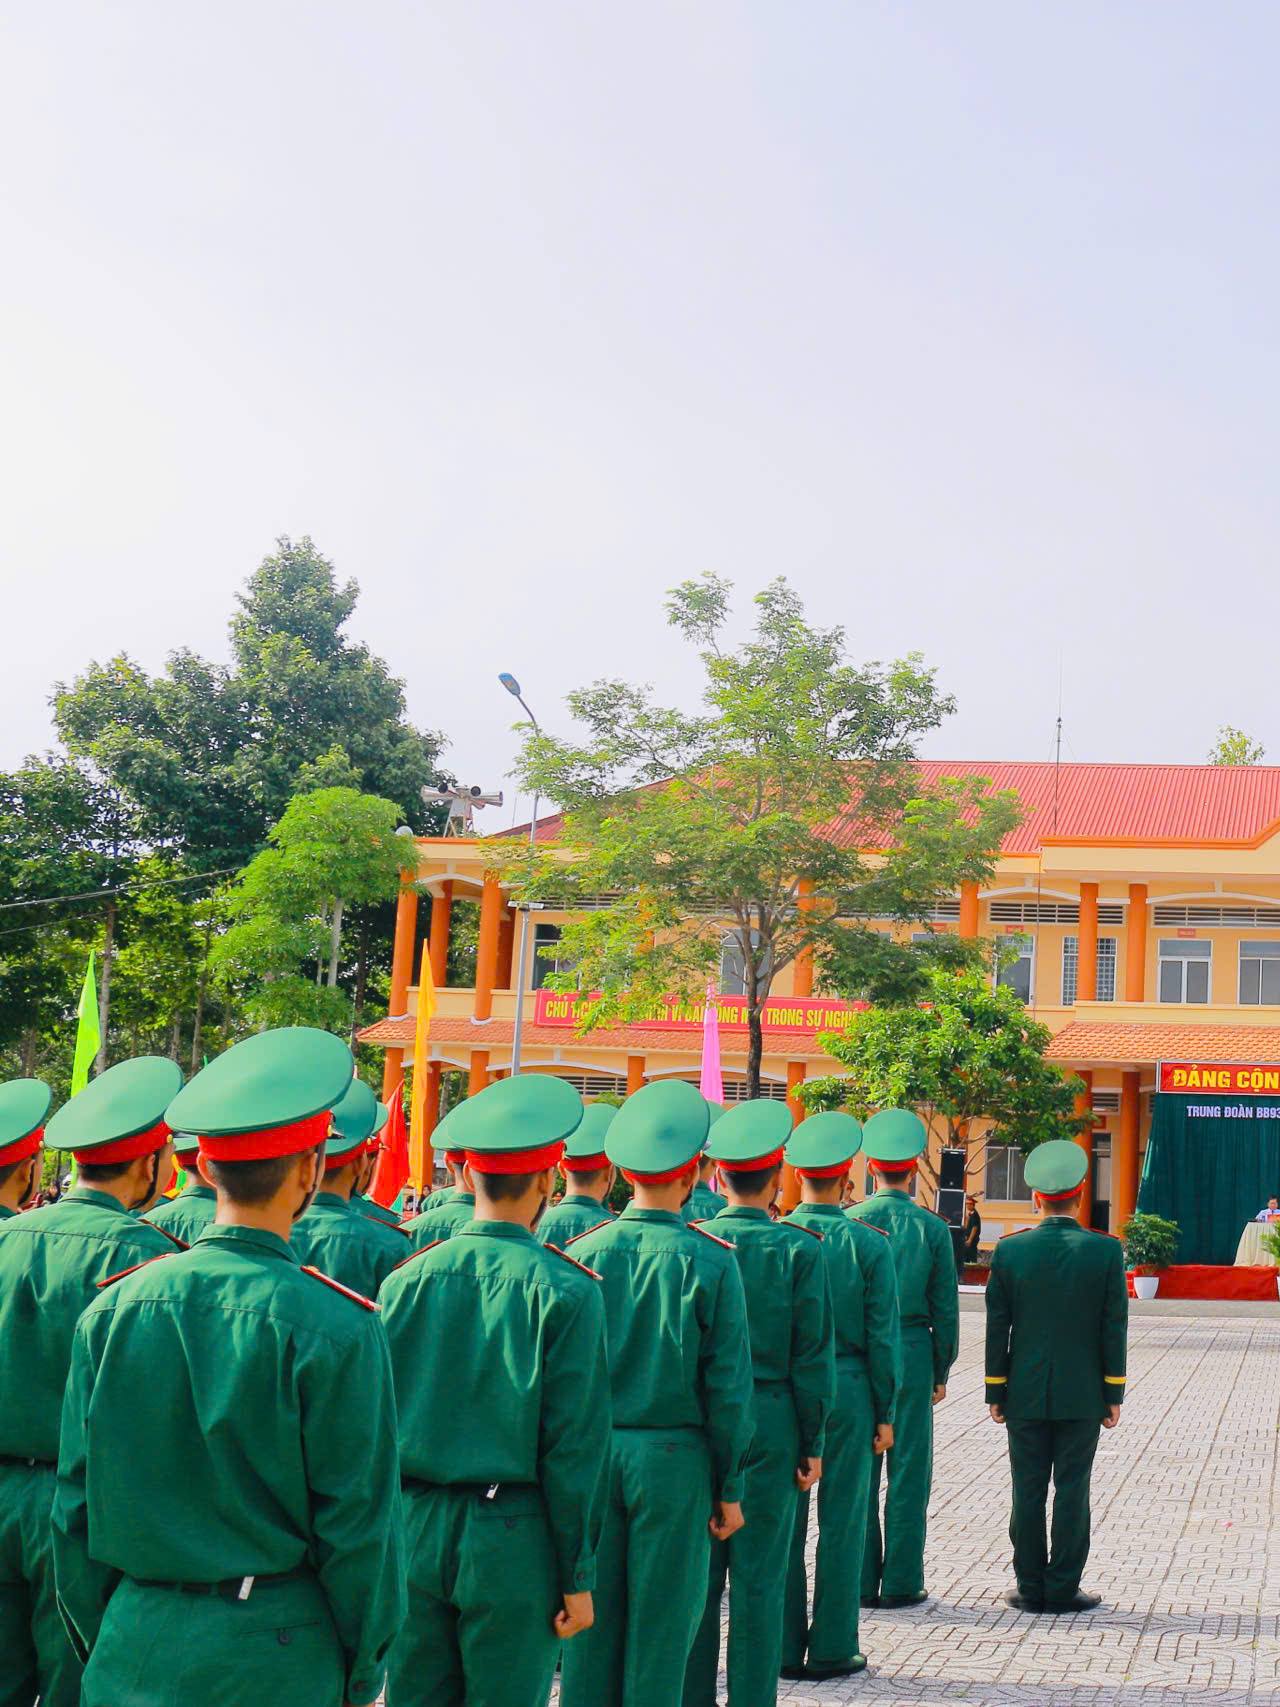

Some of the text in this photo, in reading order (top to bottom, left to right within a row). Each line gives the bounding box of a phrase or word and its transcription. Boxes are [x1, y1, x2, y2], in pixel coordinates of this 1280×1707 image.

[546, 996, 568, 1018] CHỦ
[767, 1008, 803, 1026] TRONG
[806, 1008, 823, 1030] SỰ
[1173, 1064, 1232, 1088] ĐẢNG
[1186, 1105, 1221, 1118] TRUNG
[1224, 1104, 1253, 1119] ĐOÀN
